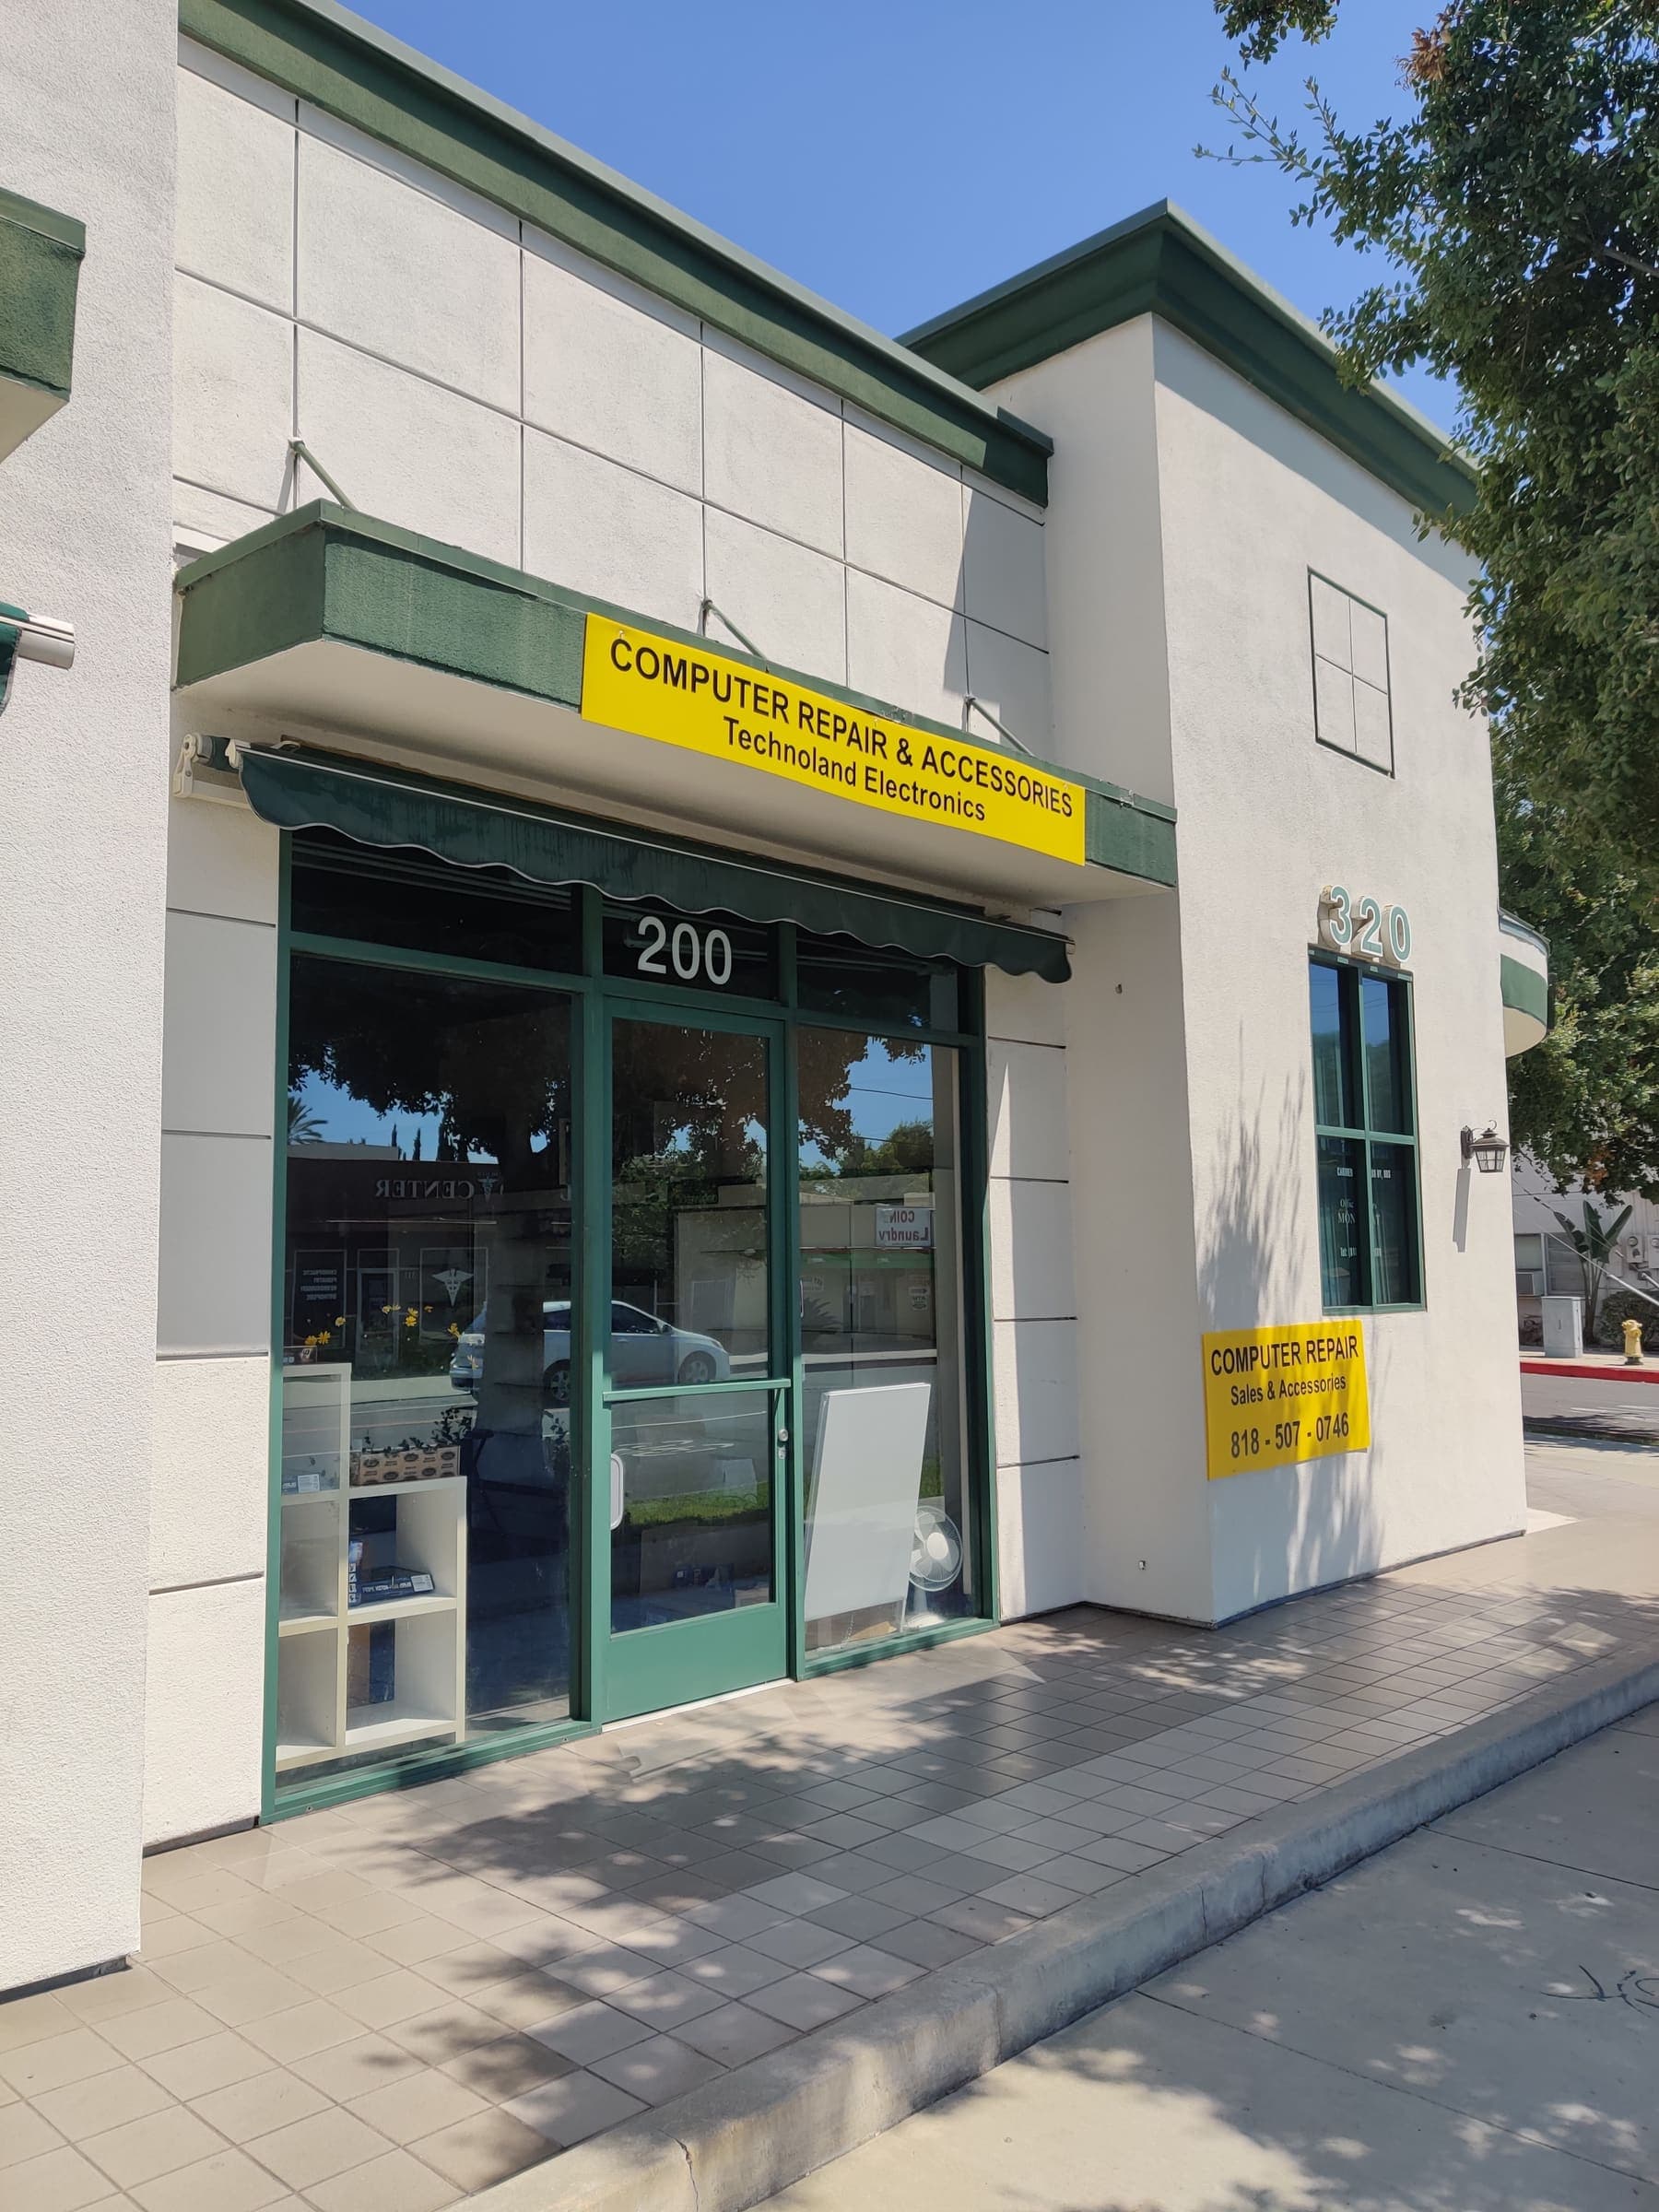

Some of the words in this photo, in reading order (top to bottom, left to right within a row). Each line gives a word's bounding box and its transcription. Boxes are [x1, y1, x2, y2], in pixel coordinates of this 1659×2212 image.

[610, 638, 789, 724] COMPUTER
[798, 700, 888, 760] REPAIR
[896, 737, 913, 767] &
[921, 746, 1073, 818] ACCESSORIES
[724, 715, 856, 787] Technoland
[865, 766, 985, 821] Electronics
[637, 915, 732, 985] 200
[1329, 885, 1412, 962] 320
[1211, 1341, 1301, 1376] COMPUTER
[1306, 1335, 1359, 1364] REPAIR
[1230, 1384, 1264, 1406] Sales
[1266, 1381, 1276, 1400] &
[1278, 1372, 1347, 1399] Accessories
[1230, 1428, 1260, 1459] 818
[1276, 1420, 1300, 1451] 507
[1316, 1412, 1349, 1442] 0746
